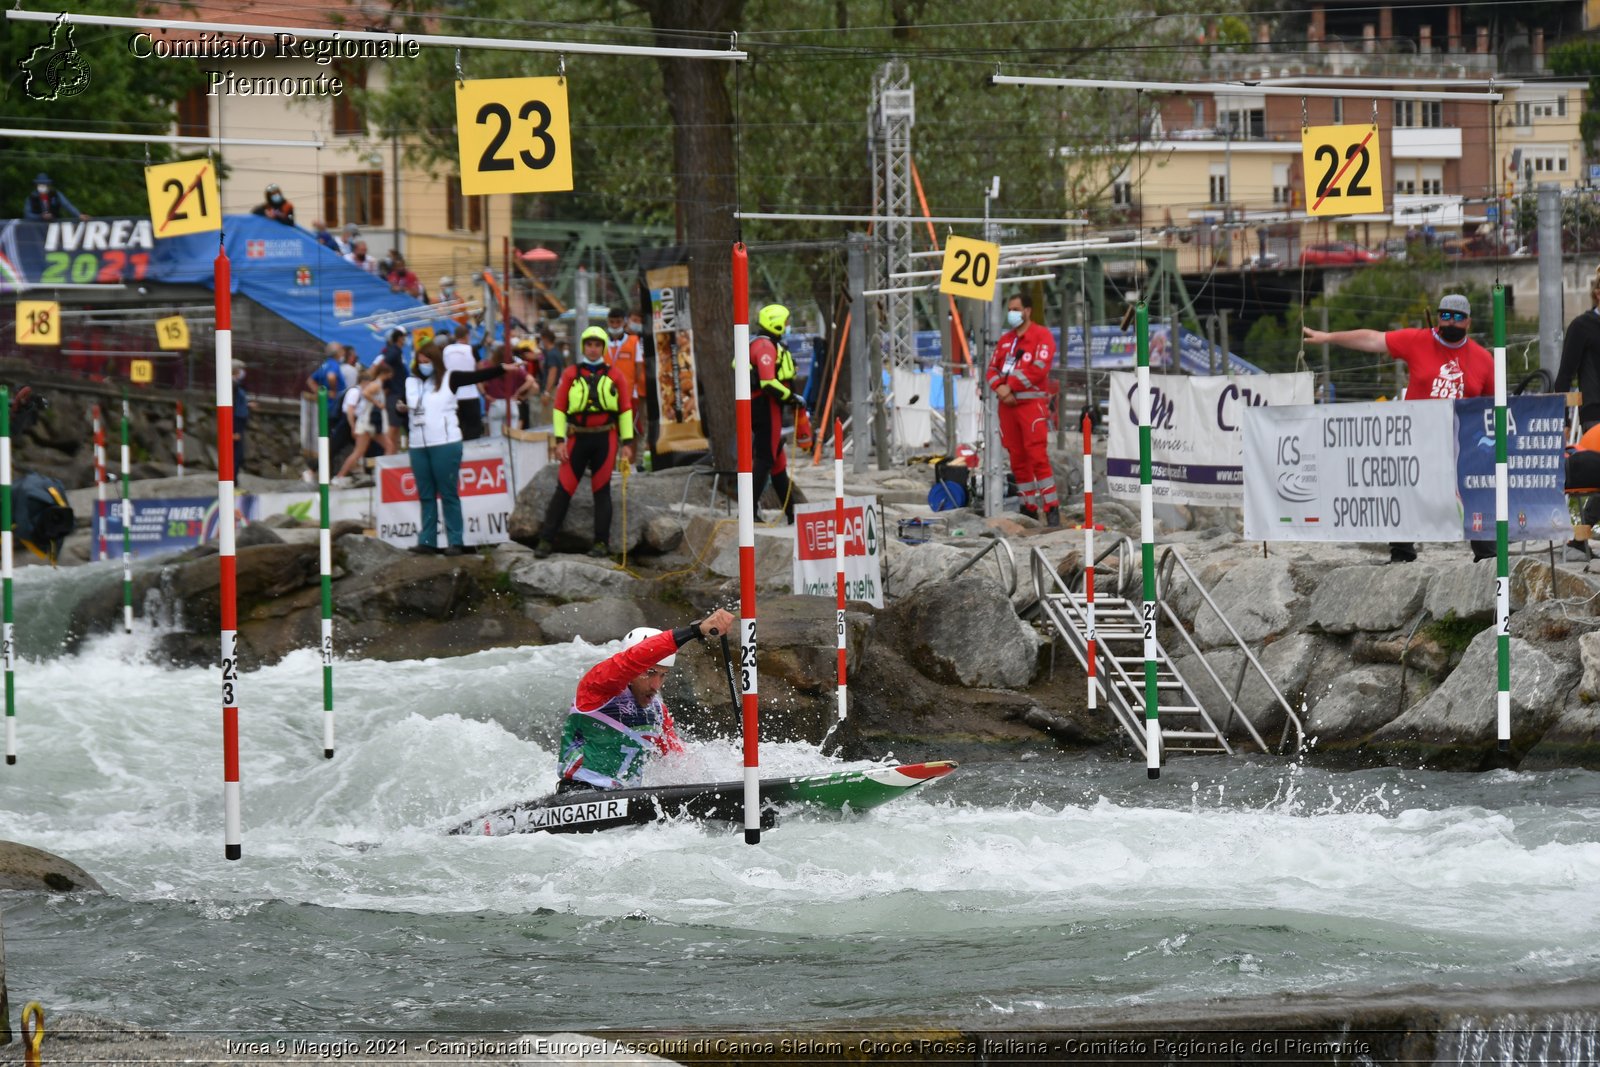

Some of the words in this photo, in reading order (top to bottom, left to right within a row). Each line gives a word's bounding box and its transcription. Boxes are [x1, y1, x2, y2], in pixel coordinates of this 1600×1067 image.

[475, 99, 556, 173] 23
[1313, 142, 1373, 198] 22
[161, 174, 208, 222] 21
[45, 219, 153, 250] IVREA
[40, 251, 149, 284] 2021
[950, 249, 990, 287] 20
[26, 310, 50, 335] 18
[661, 287, 675, 331] KIND
[163, 322, 182, 340] 15
[1323, 416, 1382, 448] ISTITUTO
[1386, 415, 1412, 446] PER
[1484, 407, 1517, 436] EA
[1528, 418, 1564, 433] CANOE
[1277, 436, 1301, 466] ICS
[1508, 455, 1559, 469] UROPEAN
[1347, 457, 1359, 487] IL
[1362, 456, 1420, 487] CREDITO
[1464, 474, 1557, 489] CHAMONSHIPS
[468, 517, 480, 533] 21
[1334, 497, 1400, 528] SPORTIVO
[381, 522, 419, 539] PIAZZA
[806, 515, 865, 551] DESAR
[838, 611, 844, 635] 20
[500, 802, 602, 828] AZINGARI
[608, 801, 623, 817] R.
